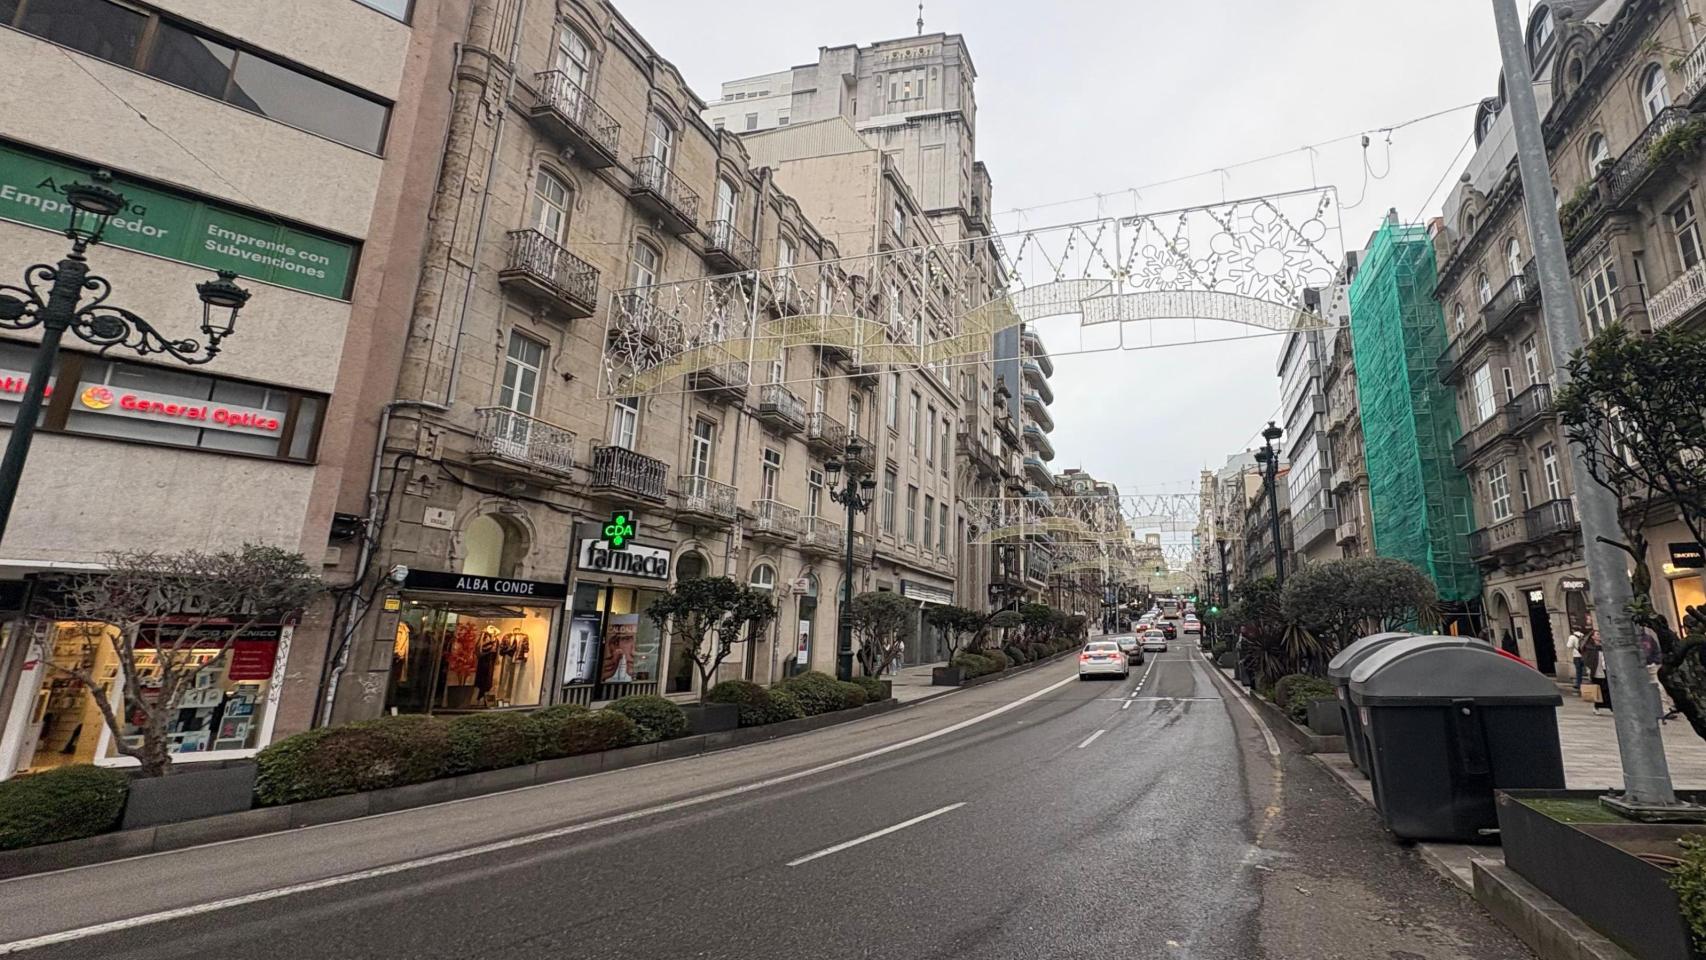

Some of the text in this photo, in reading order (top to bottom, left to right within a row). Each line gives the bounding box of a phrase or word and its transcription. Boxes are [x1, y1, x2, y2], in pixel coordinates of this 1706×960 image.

[204, 239, 326, 279] Subvenciones
[207, 224, 329, 265] Emprende con
[119, 394, 280, 431] General Optica
[605, 525, 633, 536] CDA
[456, 577, 535, 594] ALBA CONDE
